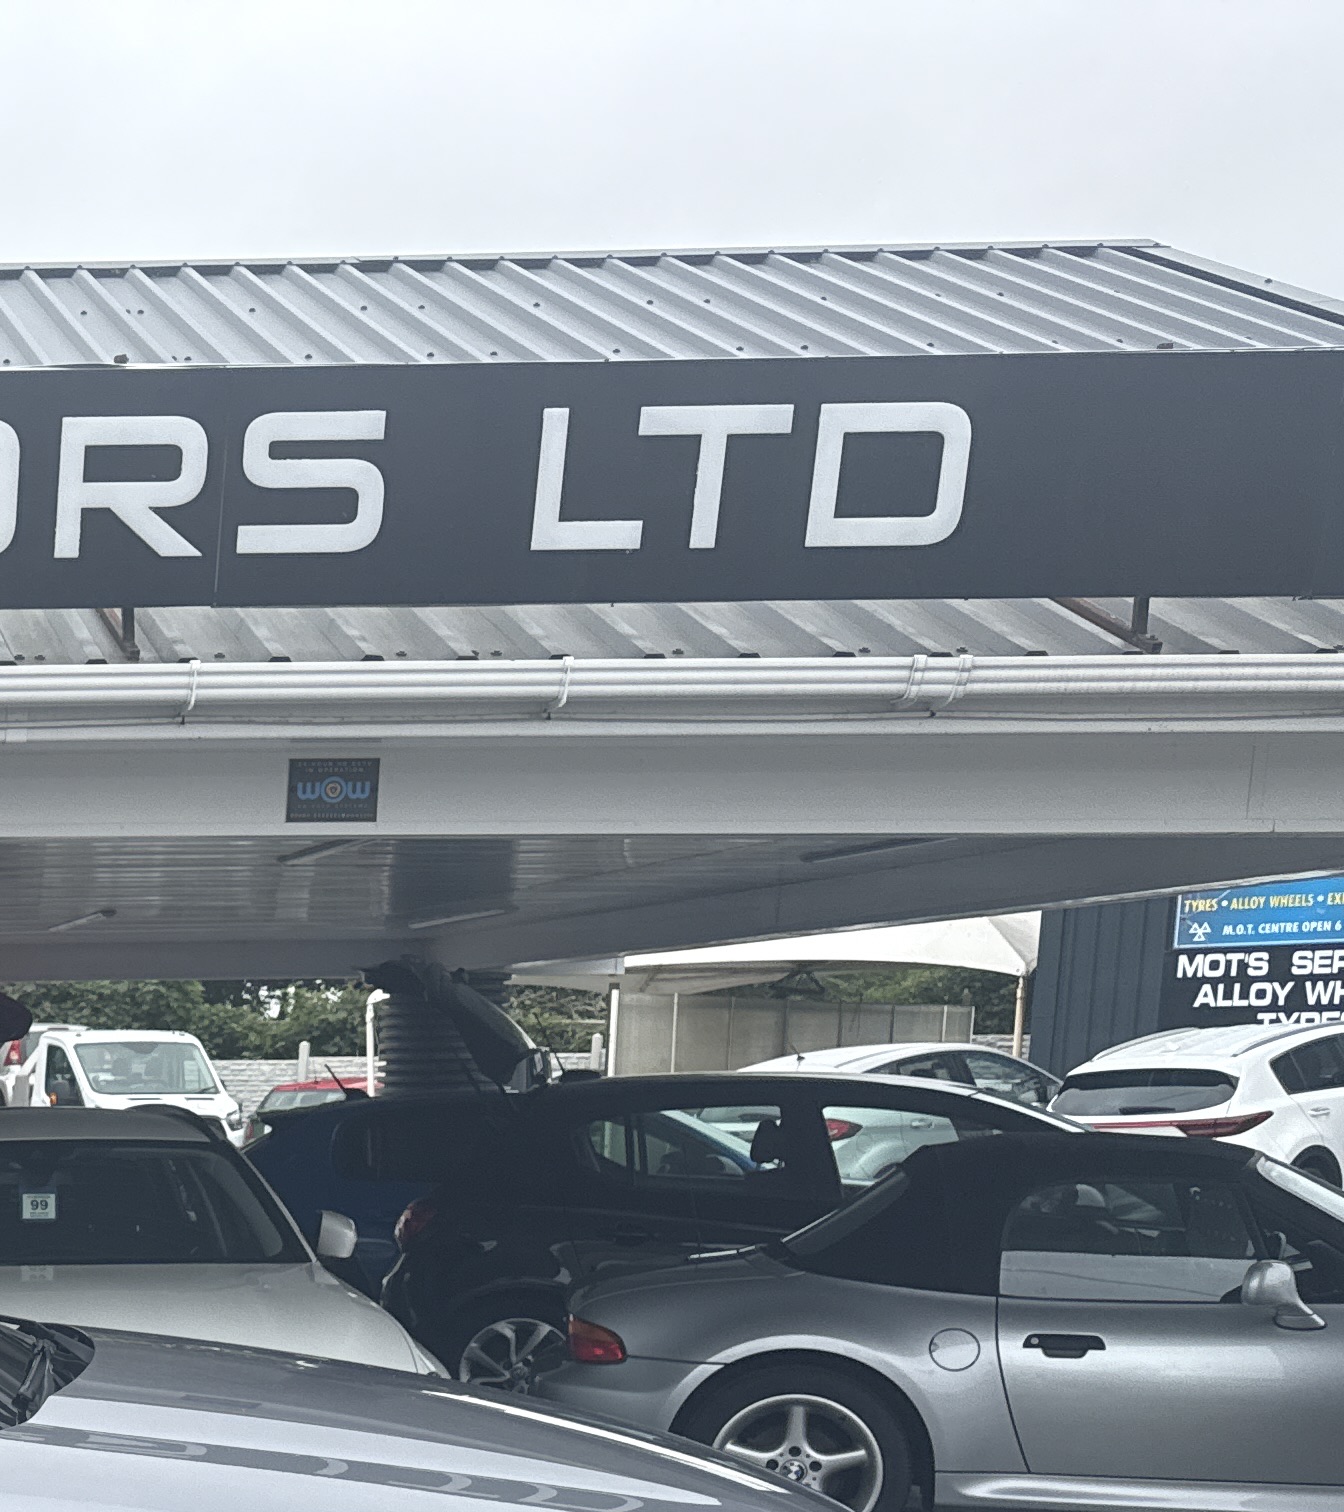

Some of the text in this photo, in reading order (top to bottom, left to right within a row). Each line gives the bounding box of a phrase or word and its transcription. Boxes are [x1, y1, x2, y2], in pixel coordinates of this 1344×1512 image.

[531, 402, 972, 551] LTD
[1184, 891, 1344, 913] TYRES ALLOY WHEELS EX
[1222, 920, 1342, 936] M.O.T. CENTRE OPEN 6
[1176, 951, 1270, 979] MOT'S
[1192, 981, 1295, 1008] ALLOY
[30, 1199, 48, 1211] 99
